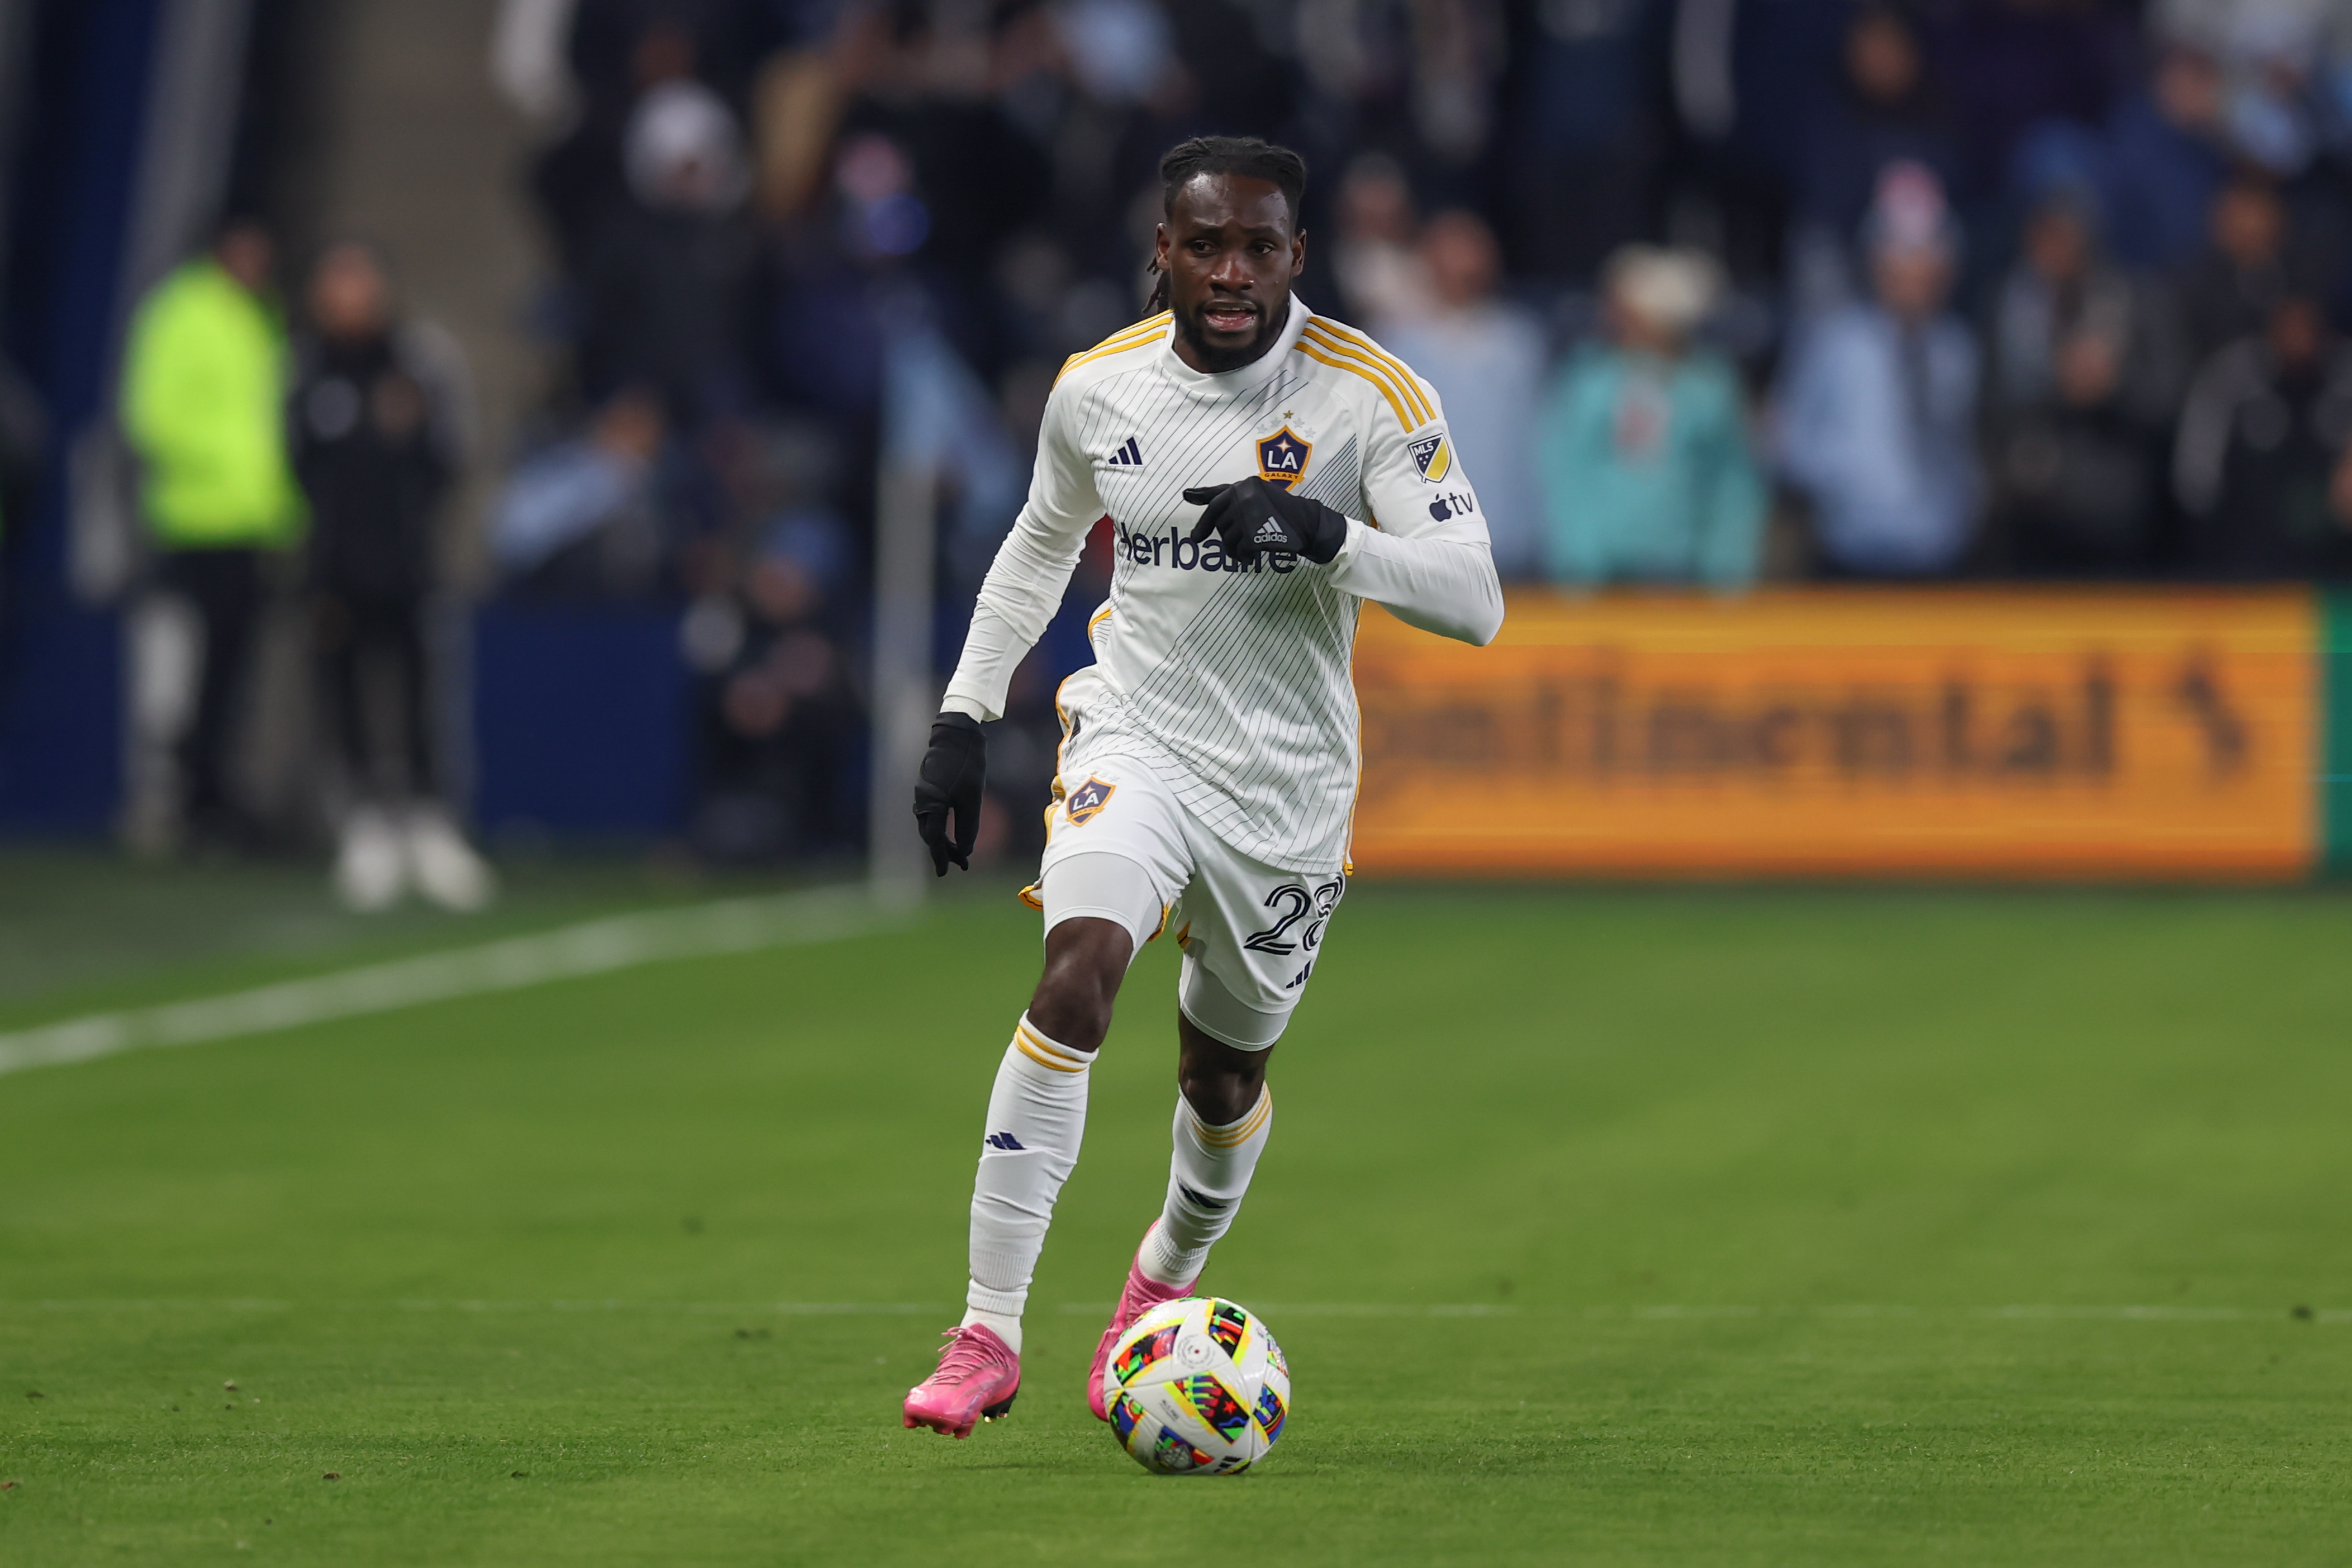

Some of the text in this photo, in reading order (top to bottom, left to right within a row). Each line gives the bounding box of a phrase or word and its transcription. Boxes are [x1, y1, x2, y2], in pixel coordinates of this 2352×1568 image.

[1414, 442, 1434, 456] MLS
[1267, 450, 1298, 470] LA
[1449, 492, 1473, 515] tv
[1254, 533, 1288, 543] adidas
[1073, 792, 1099, 811] LA
[1243, 876, 1343, 955] 28
